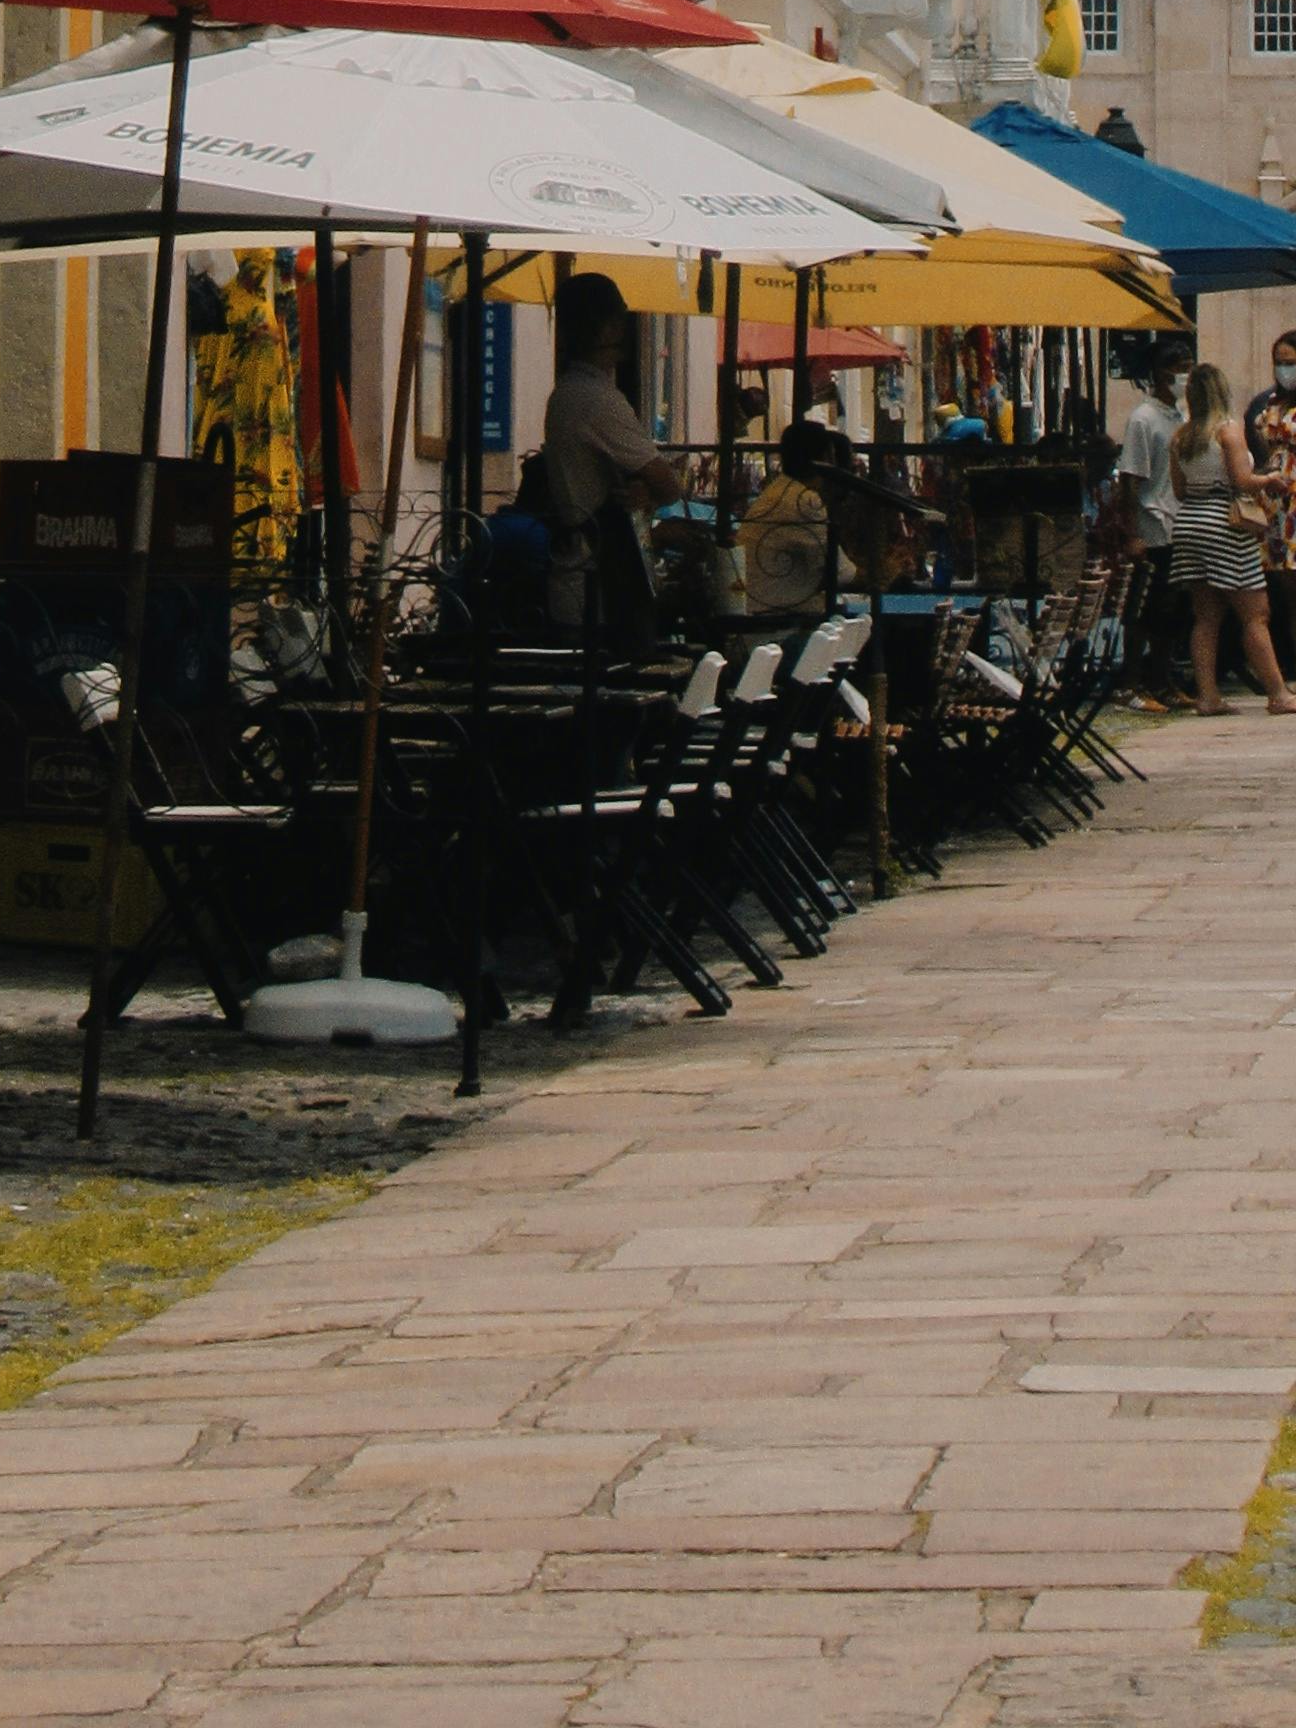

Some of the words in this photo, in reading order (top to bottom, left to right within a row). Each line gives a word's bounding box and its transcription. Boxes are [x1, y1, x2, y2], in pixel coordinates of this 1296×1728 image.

[103, 122, 317, 169] BOHEMIA
[679, 195, 832, 216] BOHEMIA
[34, 512, 119, 549] BRAHMA
